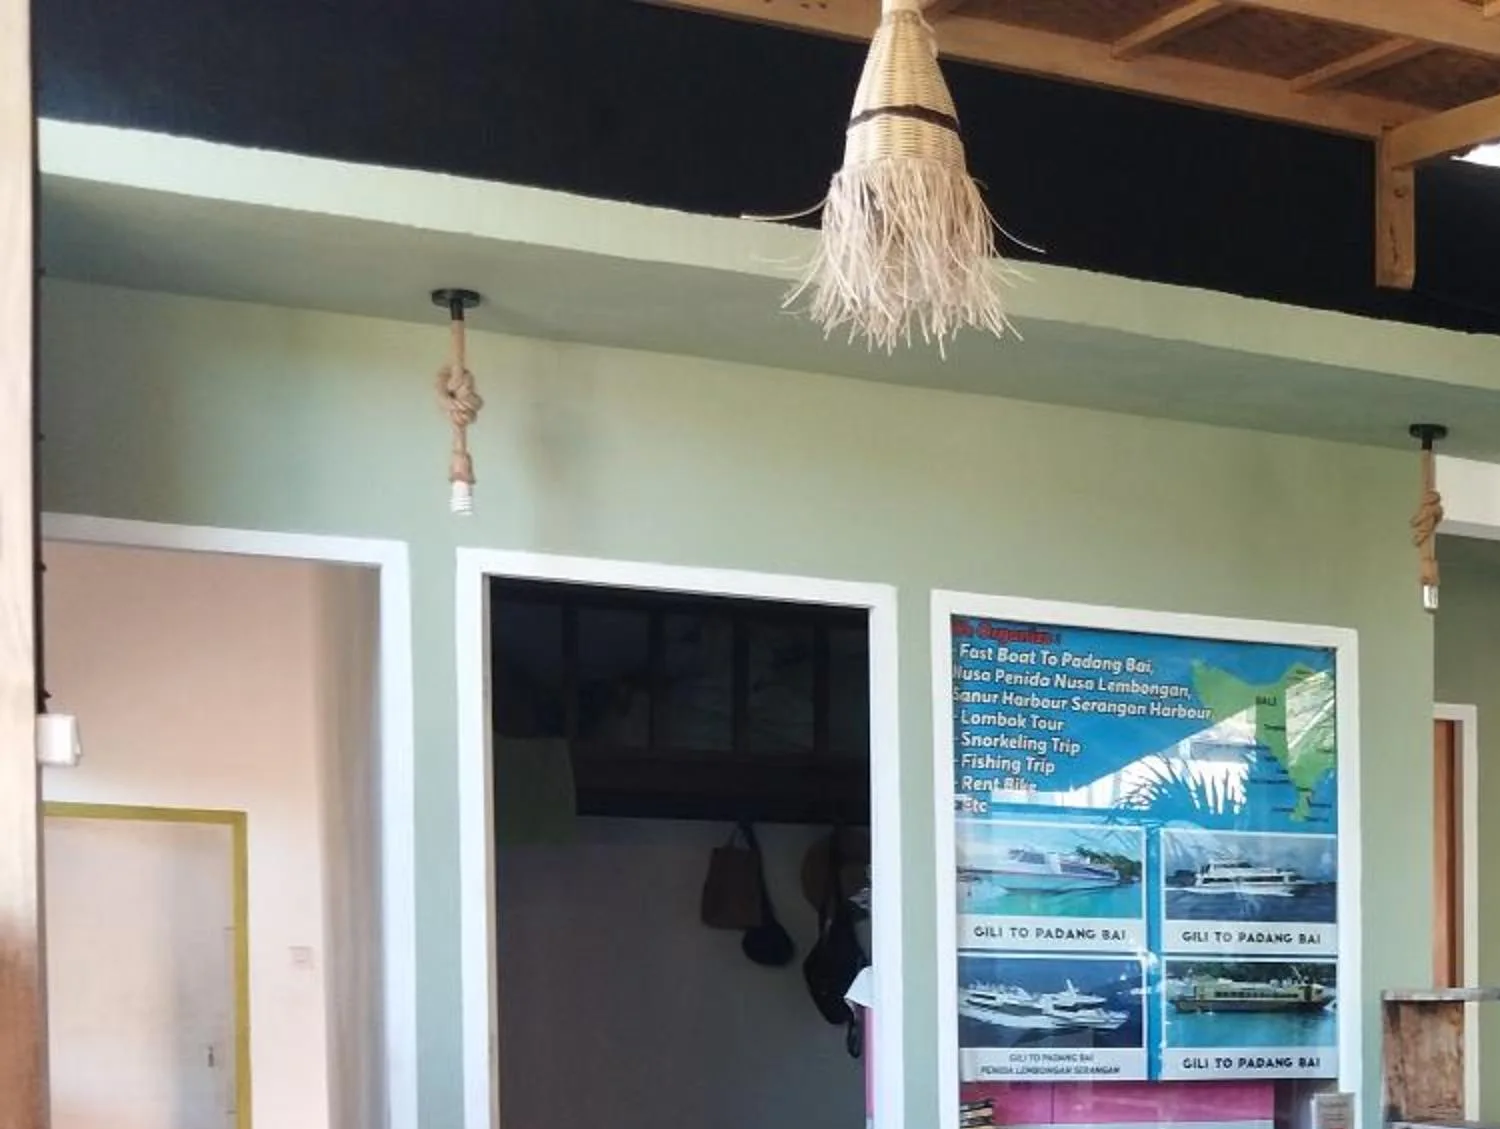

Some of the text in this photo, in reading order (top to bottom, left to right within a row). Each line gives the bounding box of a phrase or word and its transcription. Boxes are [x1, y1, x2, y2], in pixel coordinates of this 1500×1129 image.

[960, 643, 1153, 675] Fast Boat To Padang Bai,
[995, 667, 1051, 688] Penida
[1054, 673, 1095, 691] Nusa
[1097, 678, 1191, 700] Lembongan,
[1001, 690, 1069, 710] Harbour
[1071, 696, 1147, 717] Serangan
[961, 709, 1065, 731] Lombok Tour
[961, 731, 1081, 756] Snorkeling Trip
[961, 753, 1055, 776] Fishing Trip
[961, 775, 1000, 791] Rent
[973, 926, 1127, 941] GILI TO PADANG BAI
[1181, 931, 1321, 945] GILI TO PADANG BAI
[1182, 1056, 1321, 1069] GILI TO PADANG BAI
